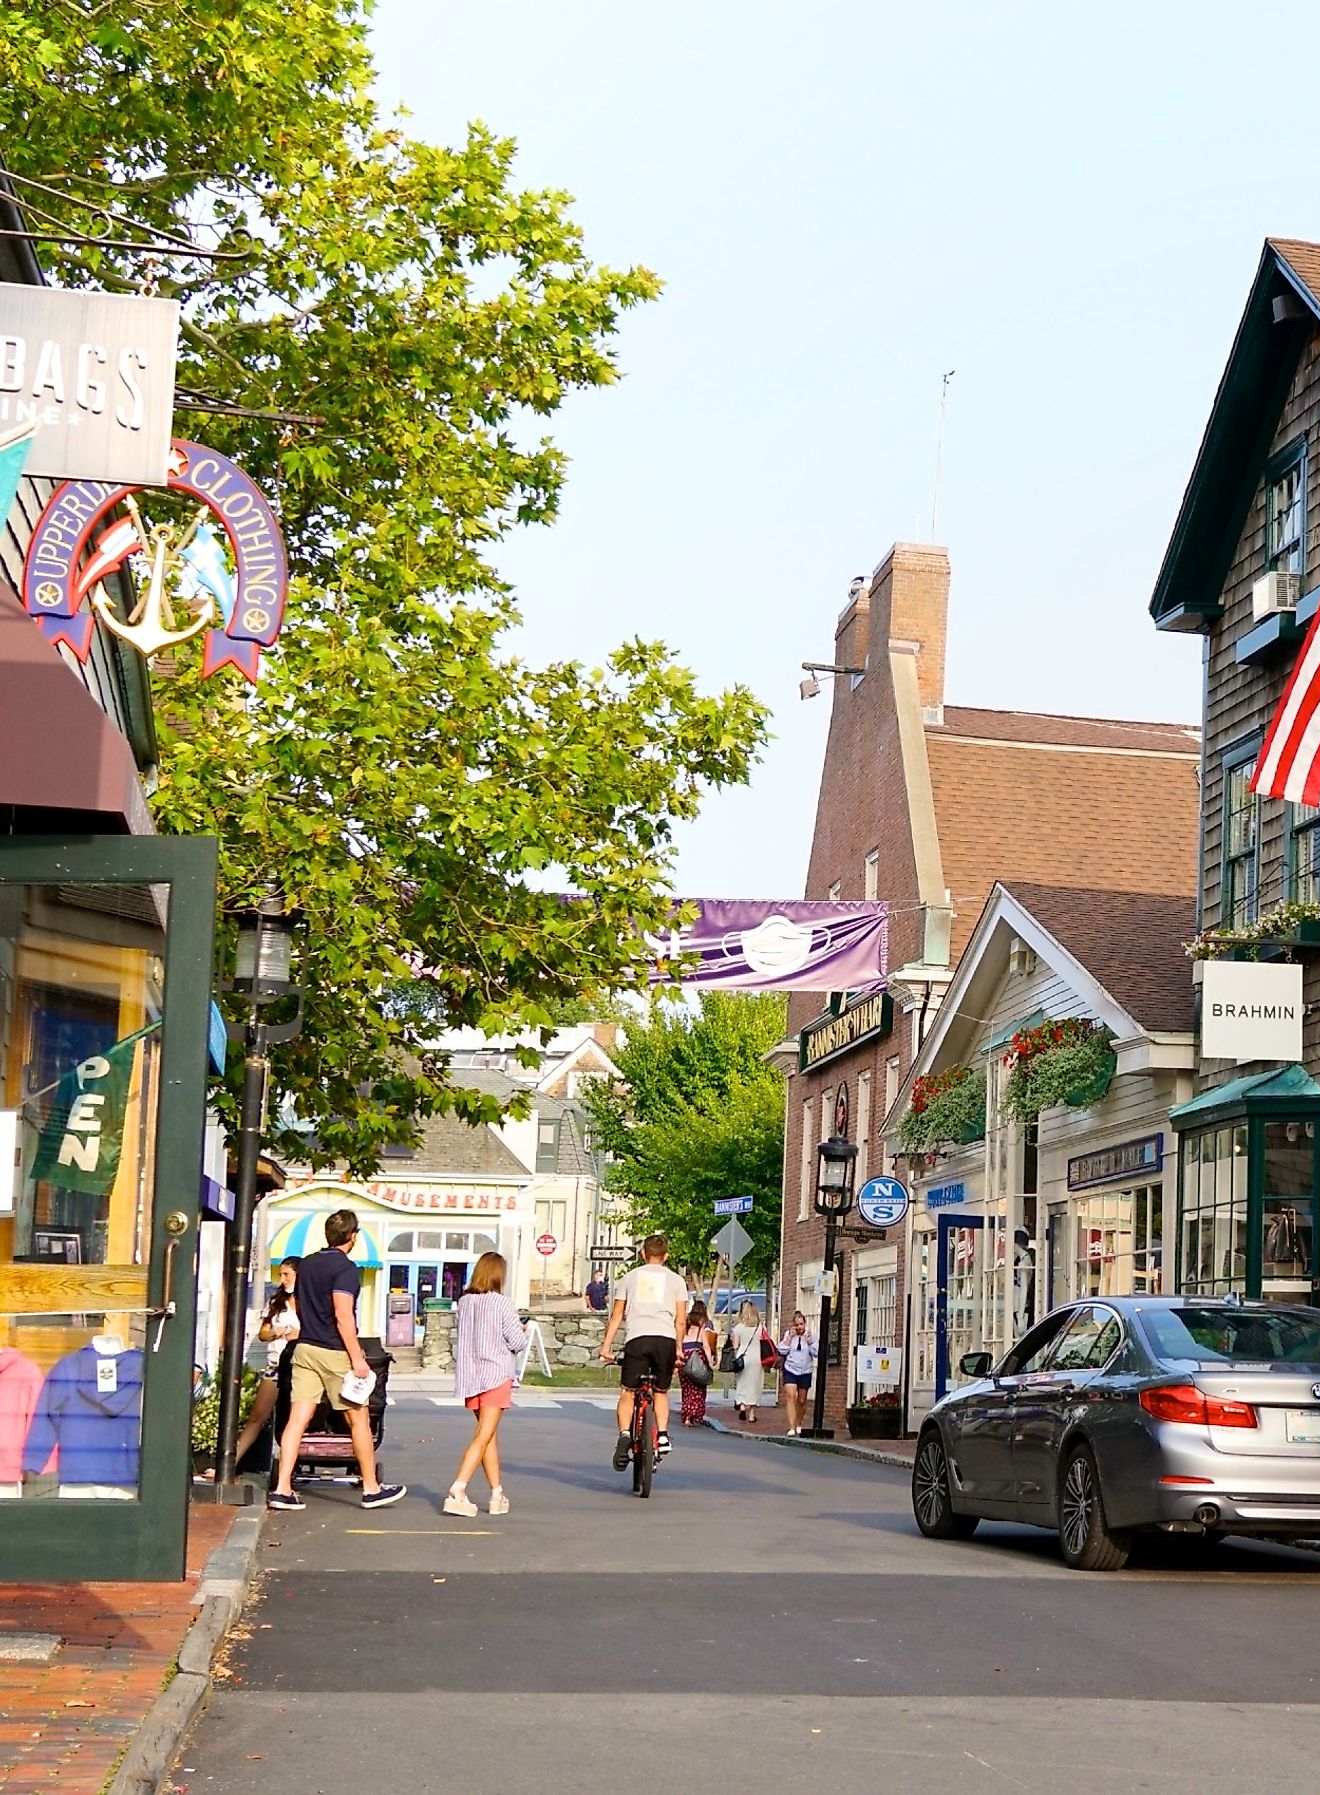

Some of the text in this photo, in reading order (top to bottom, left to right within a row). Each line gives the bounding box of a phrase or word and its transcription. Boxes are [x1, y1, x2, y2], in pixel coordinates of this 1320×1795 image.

[0, 335, 148, 431] BAGS
[190, 459, 277, 605] CLOTHING
[1212, 1003, 1294, 1020] BRAHMIN
[367, 1181, 517, 1210] AMUSEMENTS
[872, 1183, 896, 1197] N
[873, 1206, 894, 1219] S
